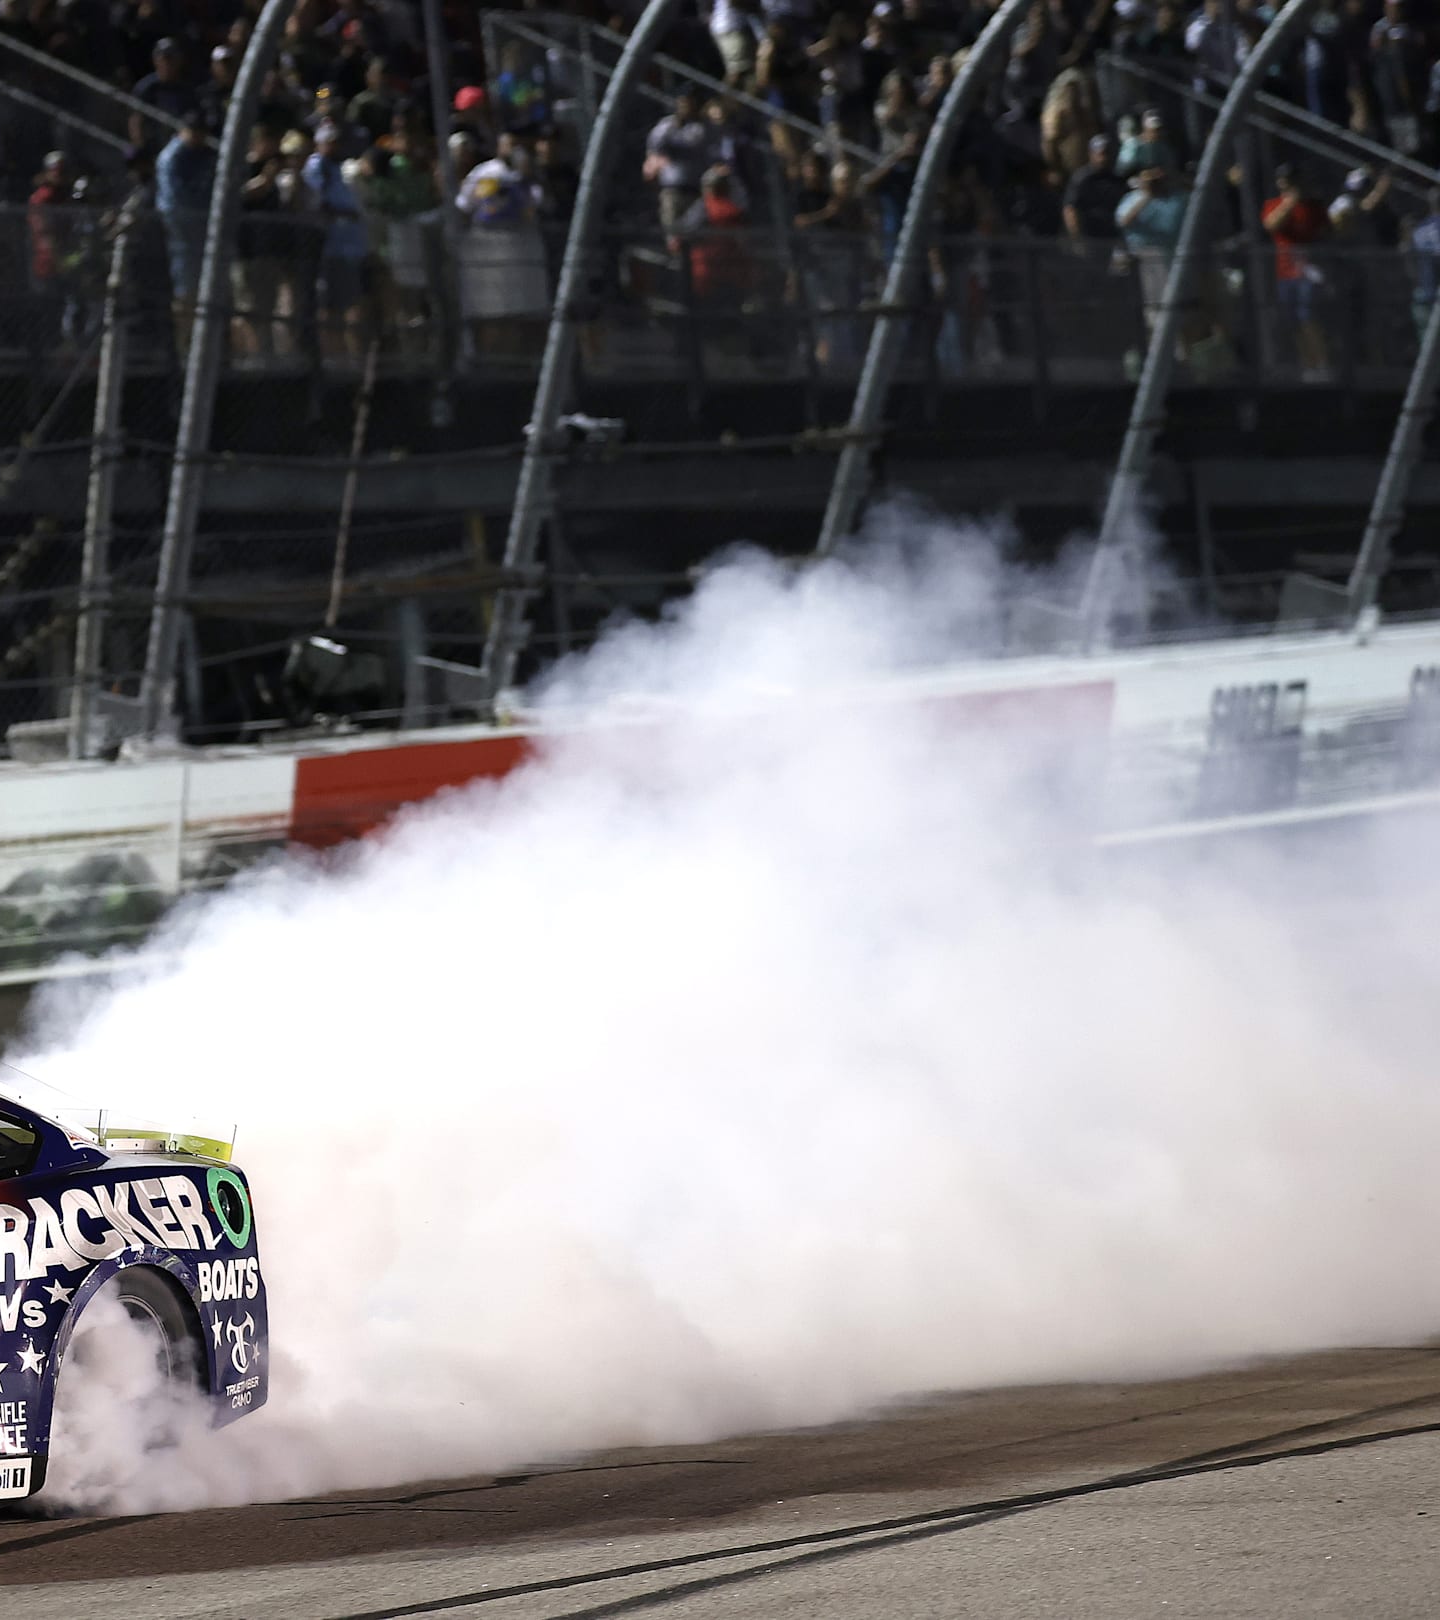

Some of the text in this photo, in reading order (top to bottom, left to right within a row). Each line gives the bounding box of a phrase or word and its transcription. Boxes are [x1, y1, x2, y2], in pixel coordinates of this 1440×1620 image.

[197, 1256, 259, 1303] BOATS
[232, 1390, 252, 1409] CAMO
[14, 1468, 24, 1487] 1
